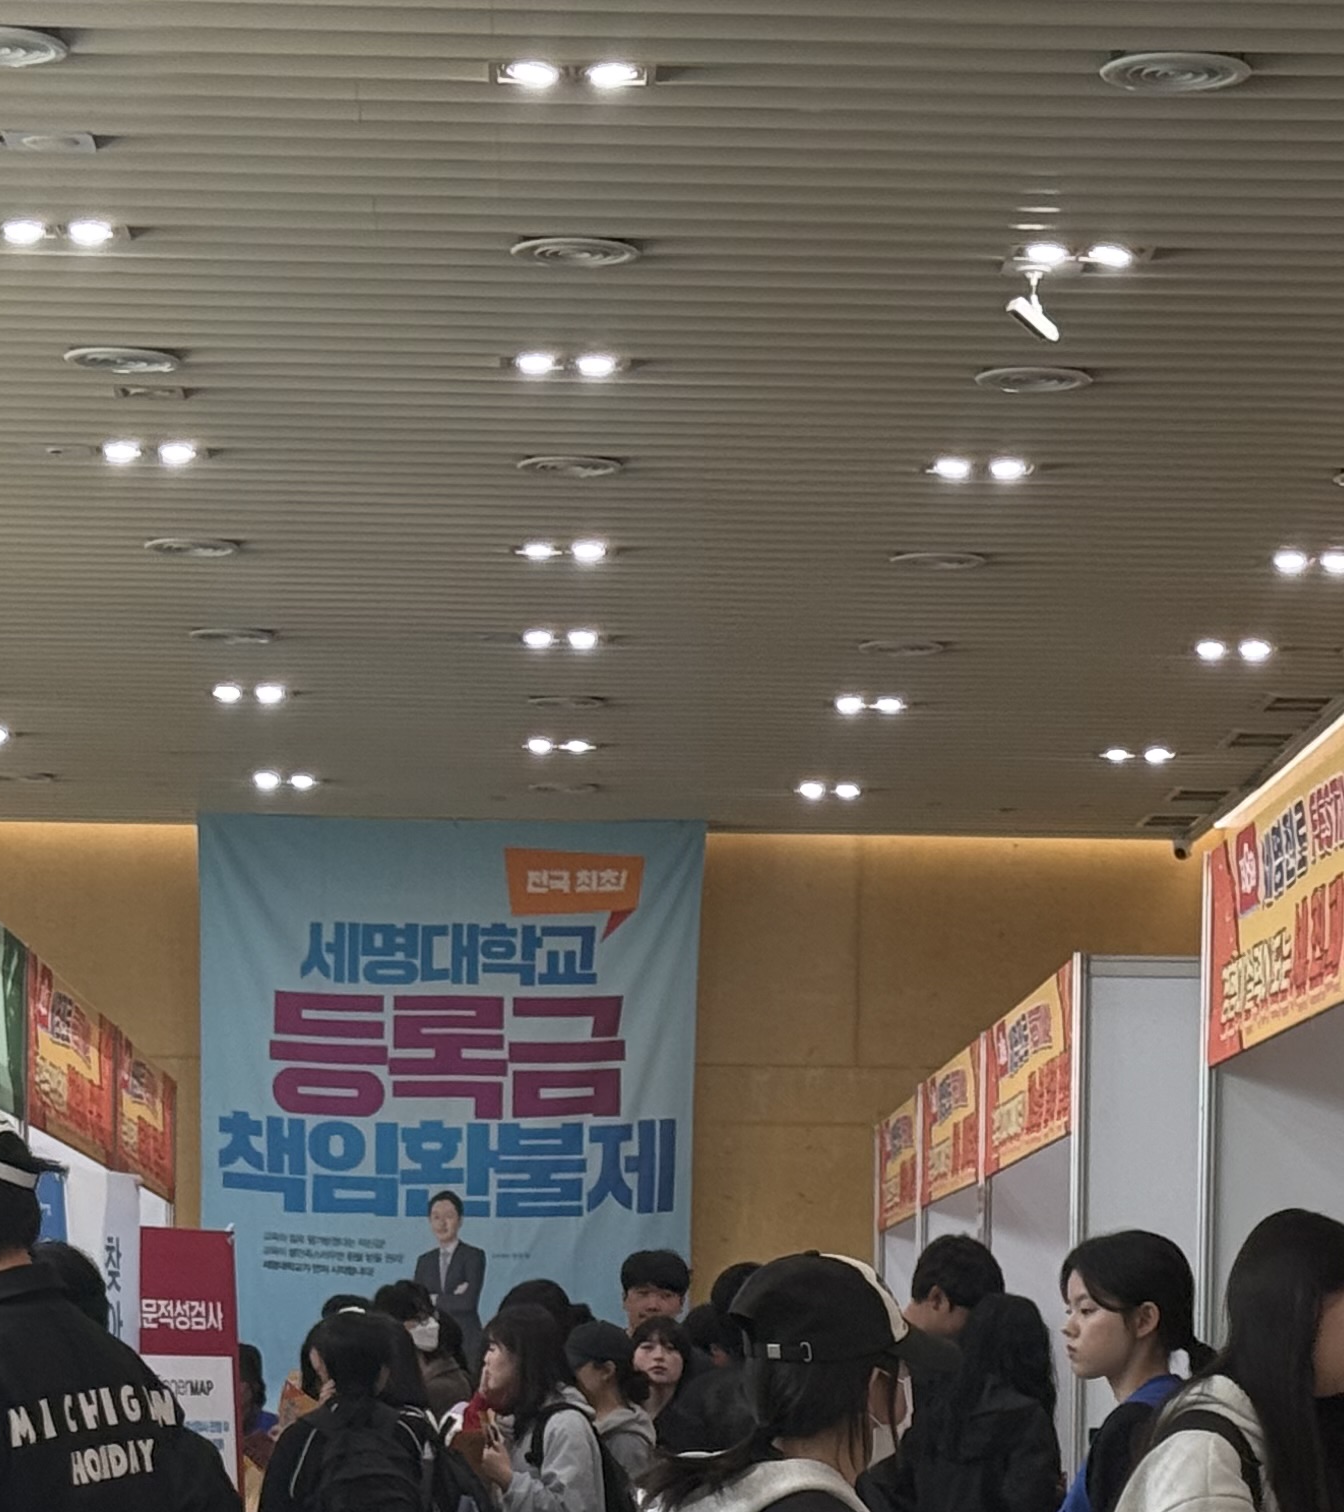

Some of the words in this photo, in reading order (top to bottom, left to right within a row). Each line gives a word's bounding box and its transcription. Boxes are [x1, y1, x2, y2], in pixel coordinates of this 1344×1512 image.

[525, 868, 571, 894] 전국
[574, 868, 629, 894] 최초!
[299, 920, 598, 988] 세명대학교
[268, 990, 626, 1120] 등록금
[217, 1110, 677, 1218] 책임환불제
